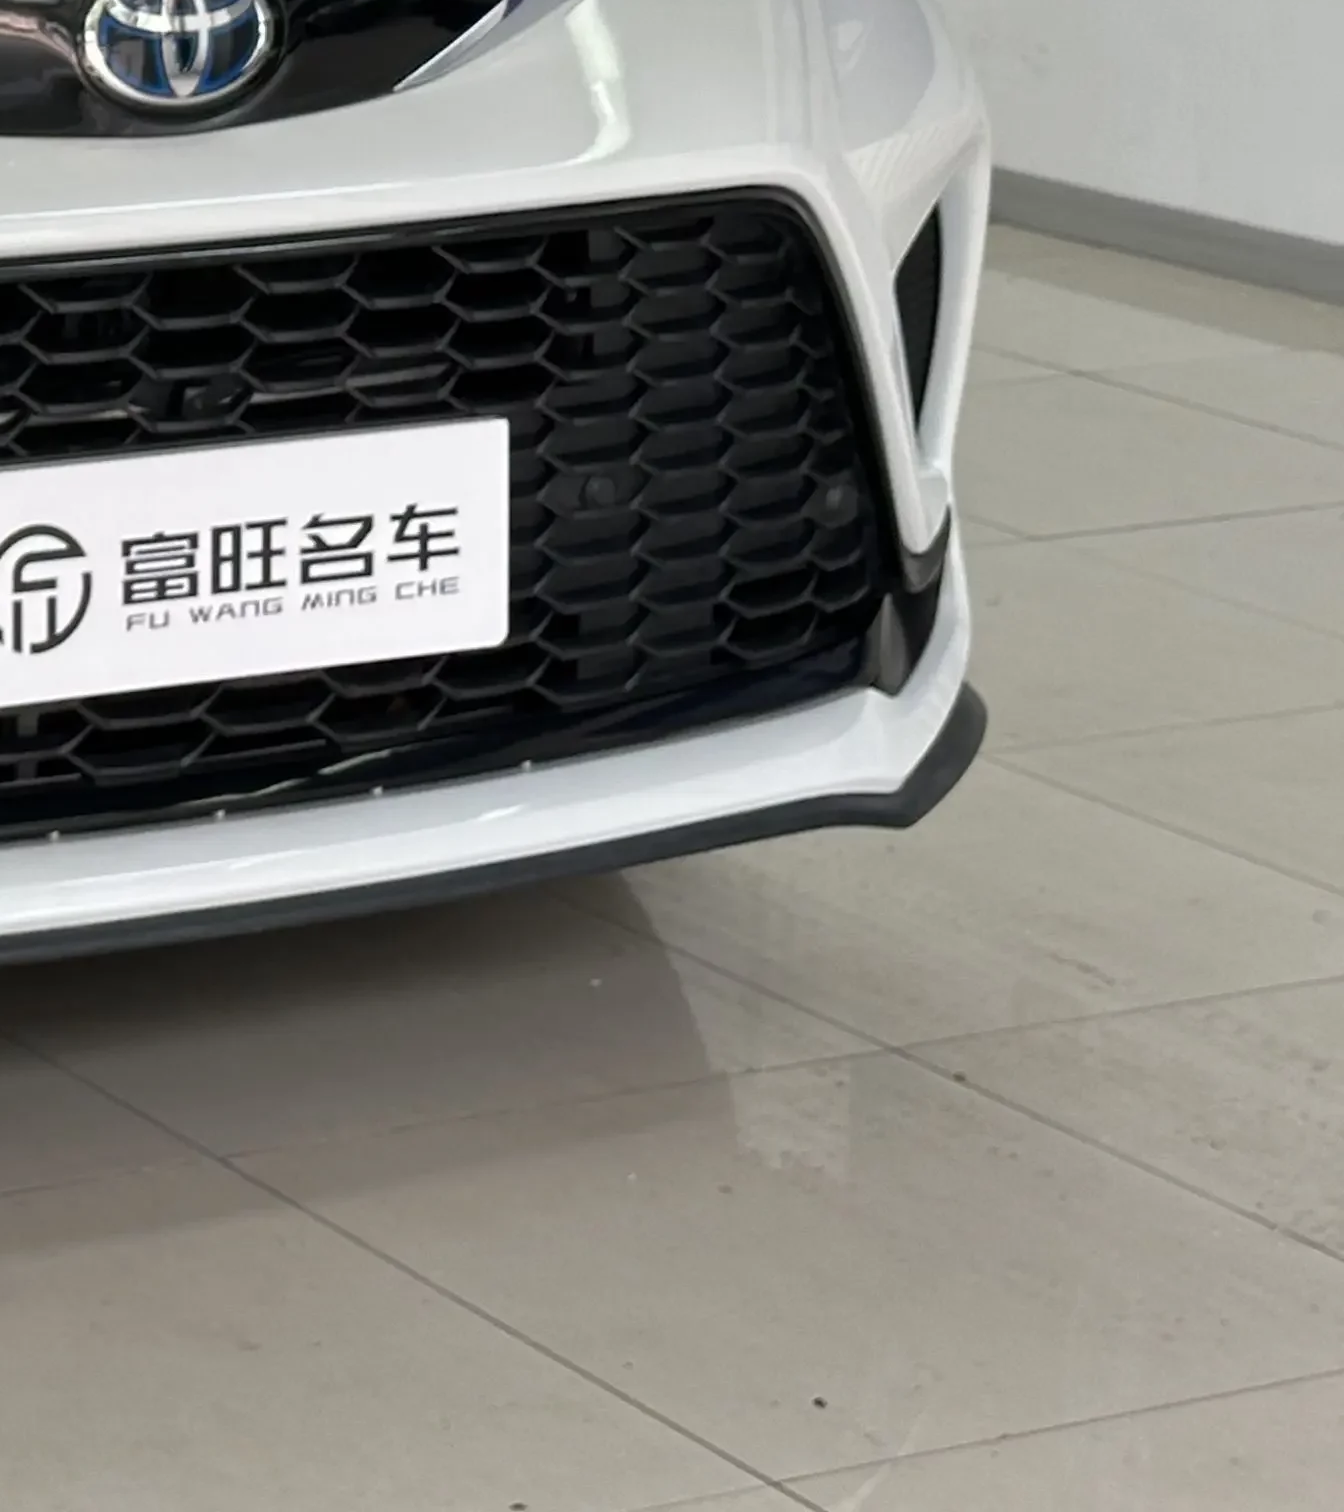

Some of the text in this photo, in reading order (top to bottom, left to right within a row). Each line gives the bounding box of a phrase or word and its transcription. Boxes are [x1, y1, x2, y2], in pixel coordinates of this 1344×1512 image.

[120, 503, 461, 606] 富旺名车
[125, 575, 460, 632] FU WANG MING CHE
